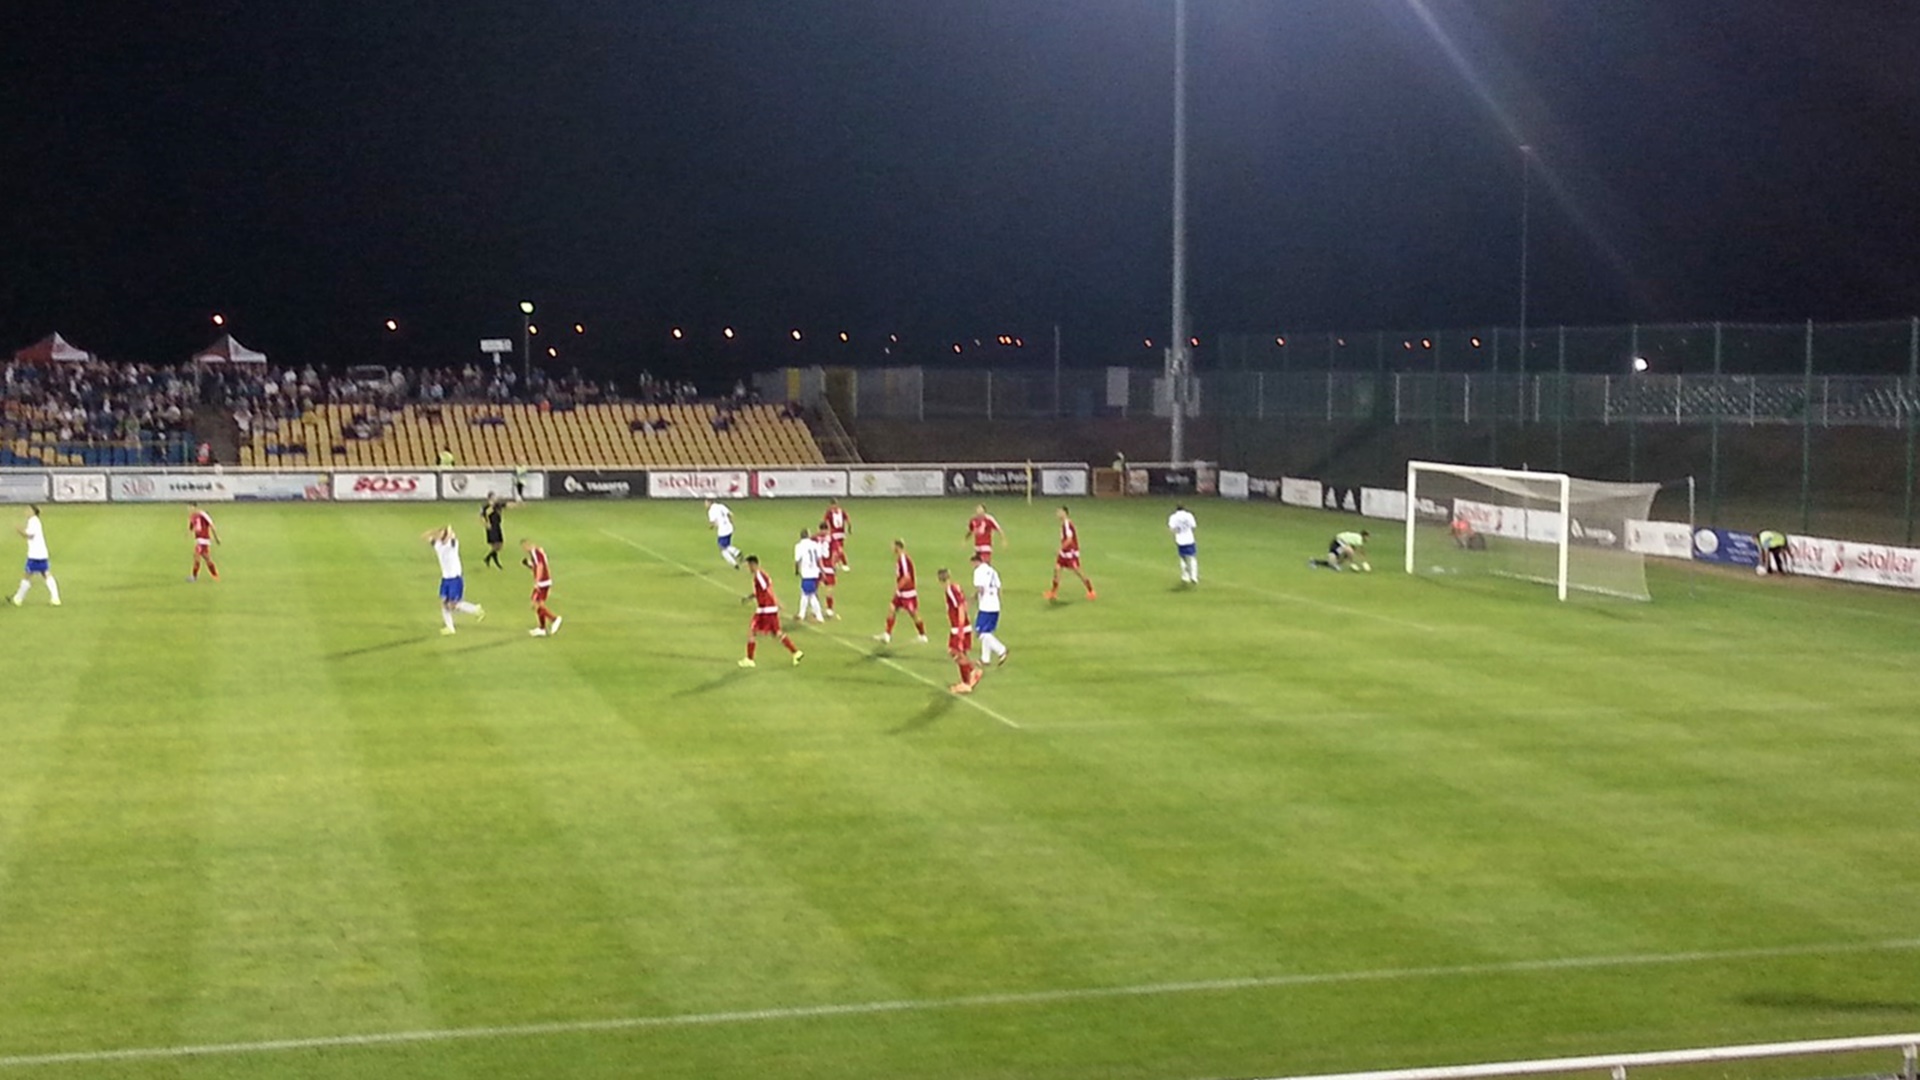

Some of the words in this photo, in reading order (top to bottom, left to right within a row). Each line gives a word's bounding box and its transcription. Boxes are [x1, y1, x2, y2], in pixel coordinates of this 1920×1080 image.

[353, 475, 419, 492] BOSS
[657, 473, 718, 489] stollar
[1857, 548, 1917, 573] stollar
